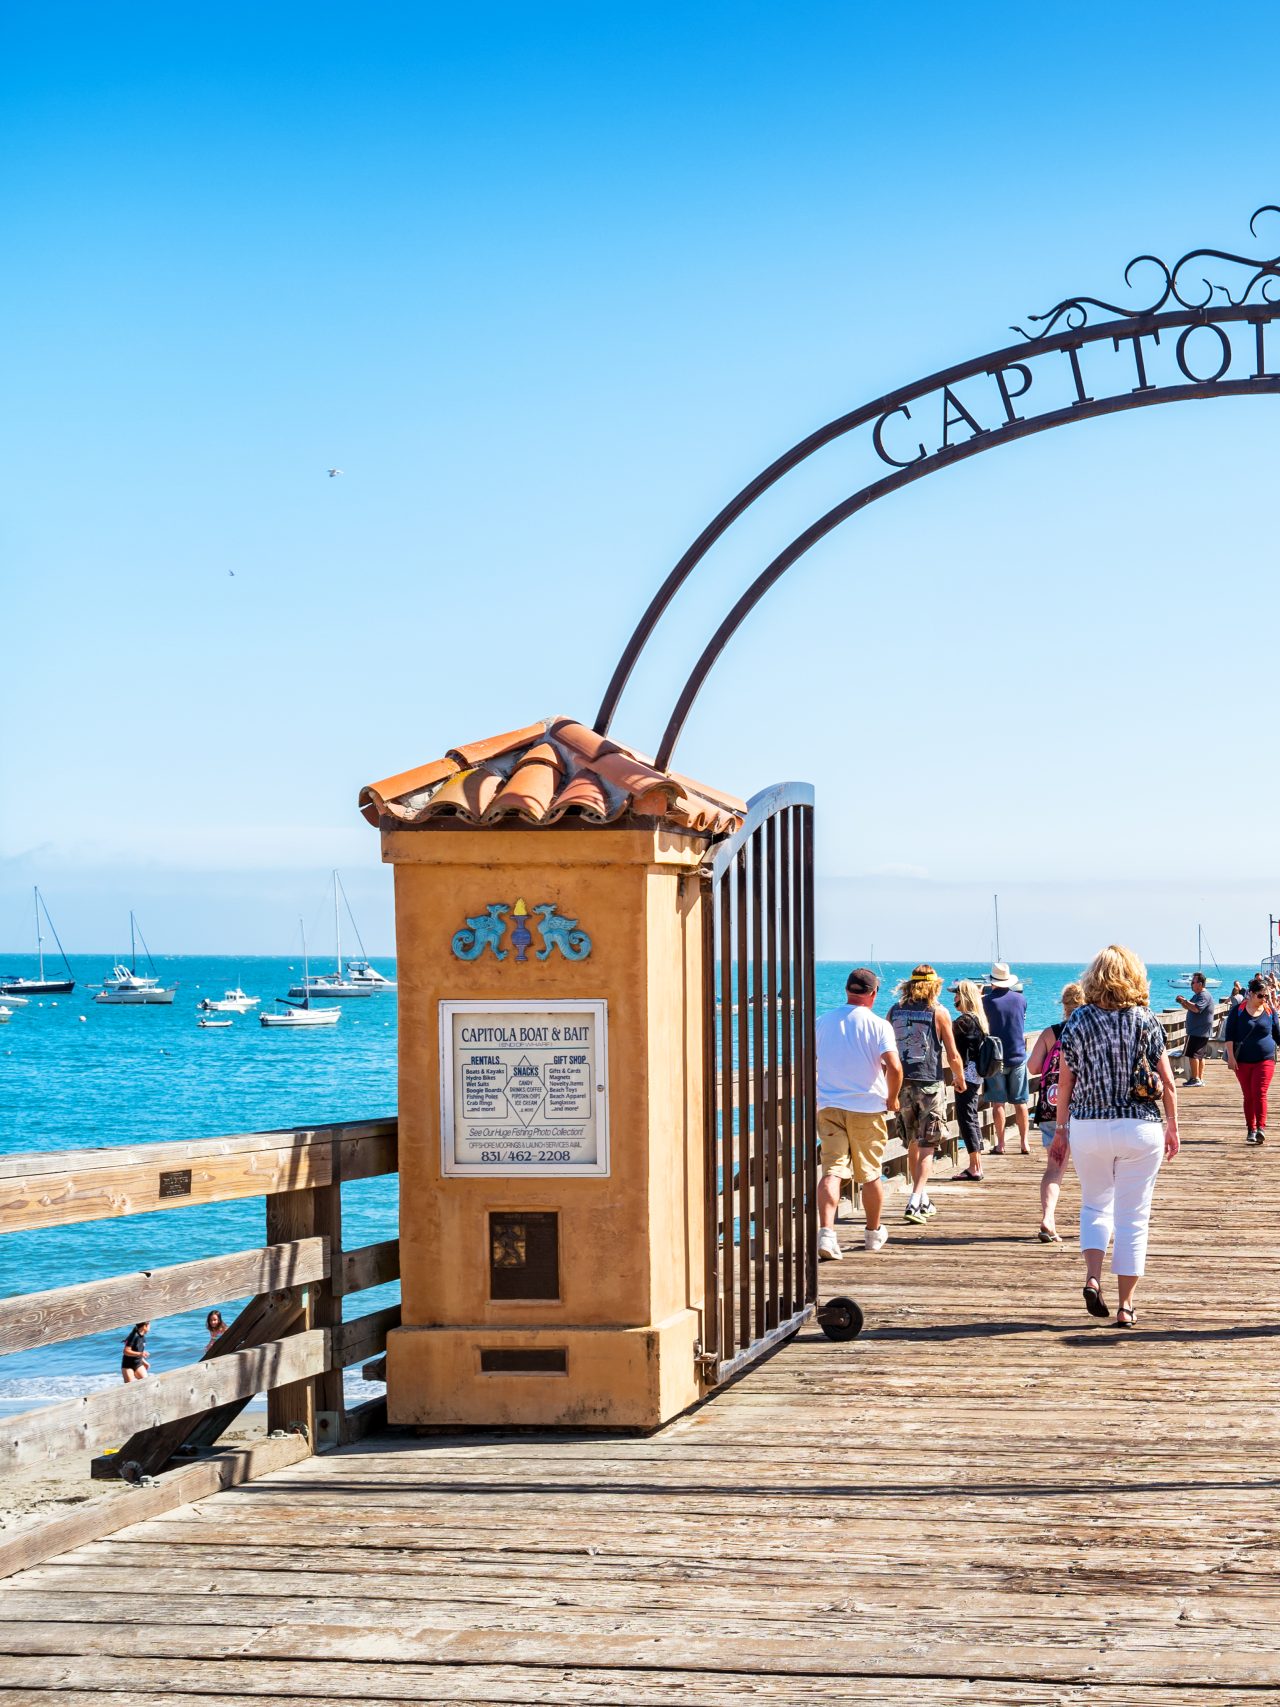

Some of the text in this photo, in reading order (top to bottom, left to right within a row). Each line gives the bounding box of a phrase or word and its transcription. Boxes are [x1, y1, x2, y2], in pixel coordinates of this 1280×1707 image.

[461, 1026, 590, 1042] CAPITOLA BOAT & BAIT
[470, 1056, 500, 1065] RENTALS
[553, 1055, 587, 1065] GIFT SHOP
[513, 1066, 539, 1076] SNACKS
[469, 1127, 584, 1139] See Our Huge Fishing Photo Collection!
[468, 1141, 496, 1149] OFFSHORE
[496, 1141, 521, 1149] MOORINGS
[481, 1150, 571, 1162] 831/462-2208
